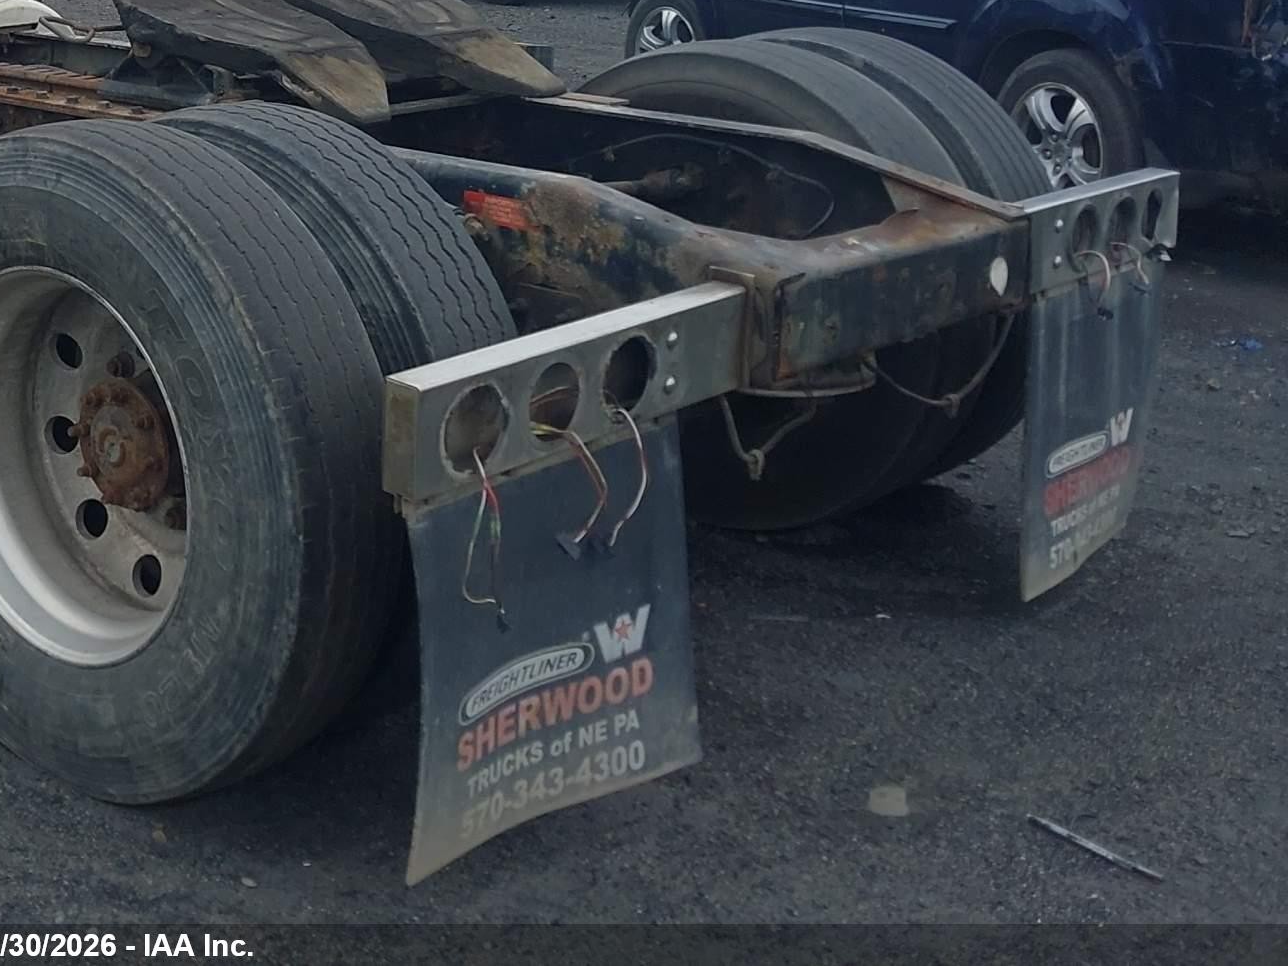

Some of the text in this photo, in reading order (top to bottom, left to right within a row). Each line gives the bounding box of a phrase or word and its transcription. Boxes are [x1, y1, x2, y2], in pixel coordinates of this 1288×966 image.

[457, 657, 654, 772] SHERWOOD
[471, 651, 578, 711] FREIGHTLINER
[462, 740, 646, 834] 570-343-4300
[467, 709, 640, 798] TRUCKS of NE PA
